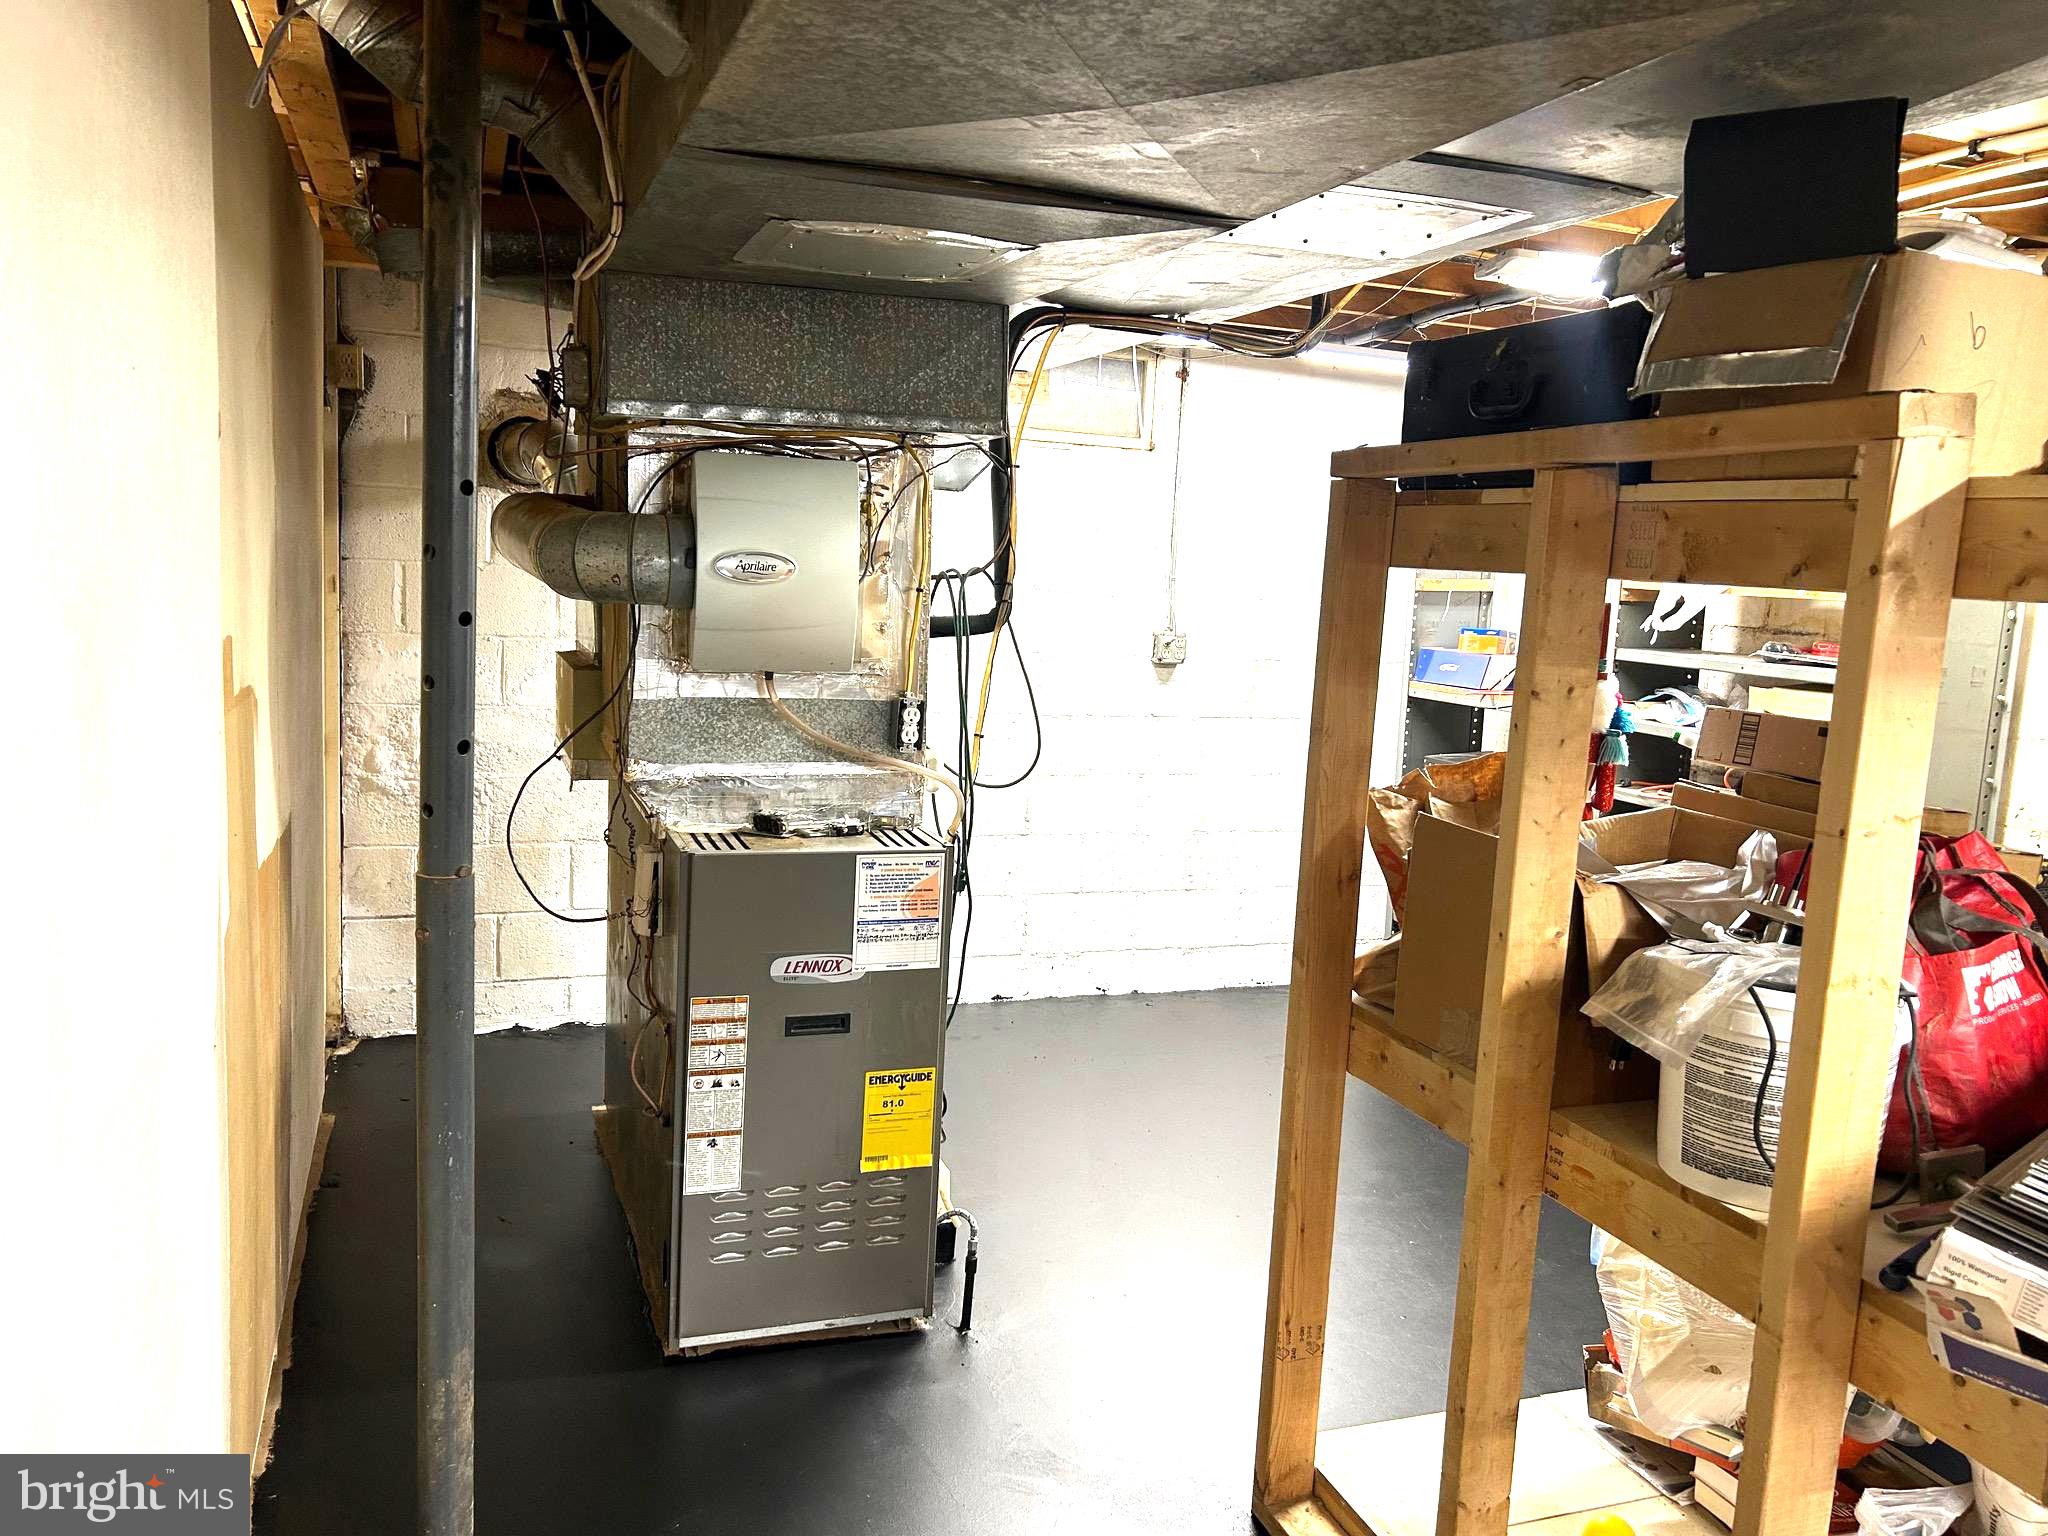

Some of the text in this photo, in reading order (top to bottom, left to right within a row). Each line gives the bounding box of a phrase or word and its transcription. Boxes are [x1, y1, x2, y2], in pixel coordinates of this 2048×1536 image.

[735, 560, 777, 573] Aprilaire
[784, 959, 844, 974] LENNOX
[868, 1071, 933, 1087] ENERGYGUIDE
[882, 1098, 904, 1108] 81.0
[1967, 1262, 2008, 1284] Waterproof
